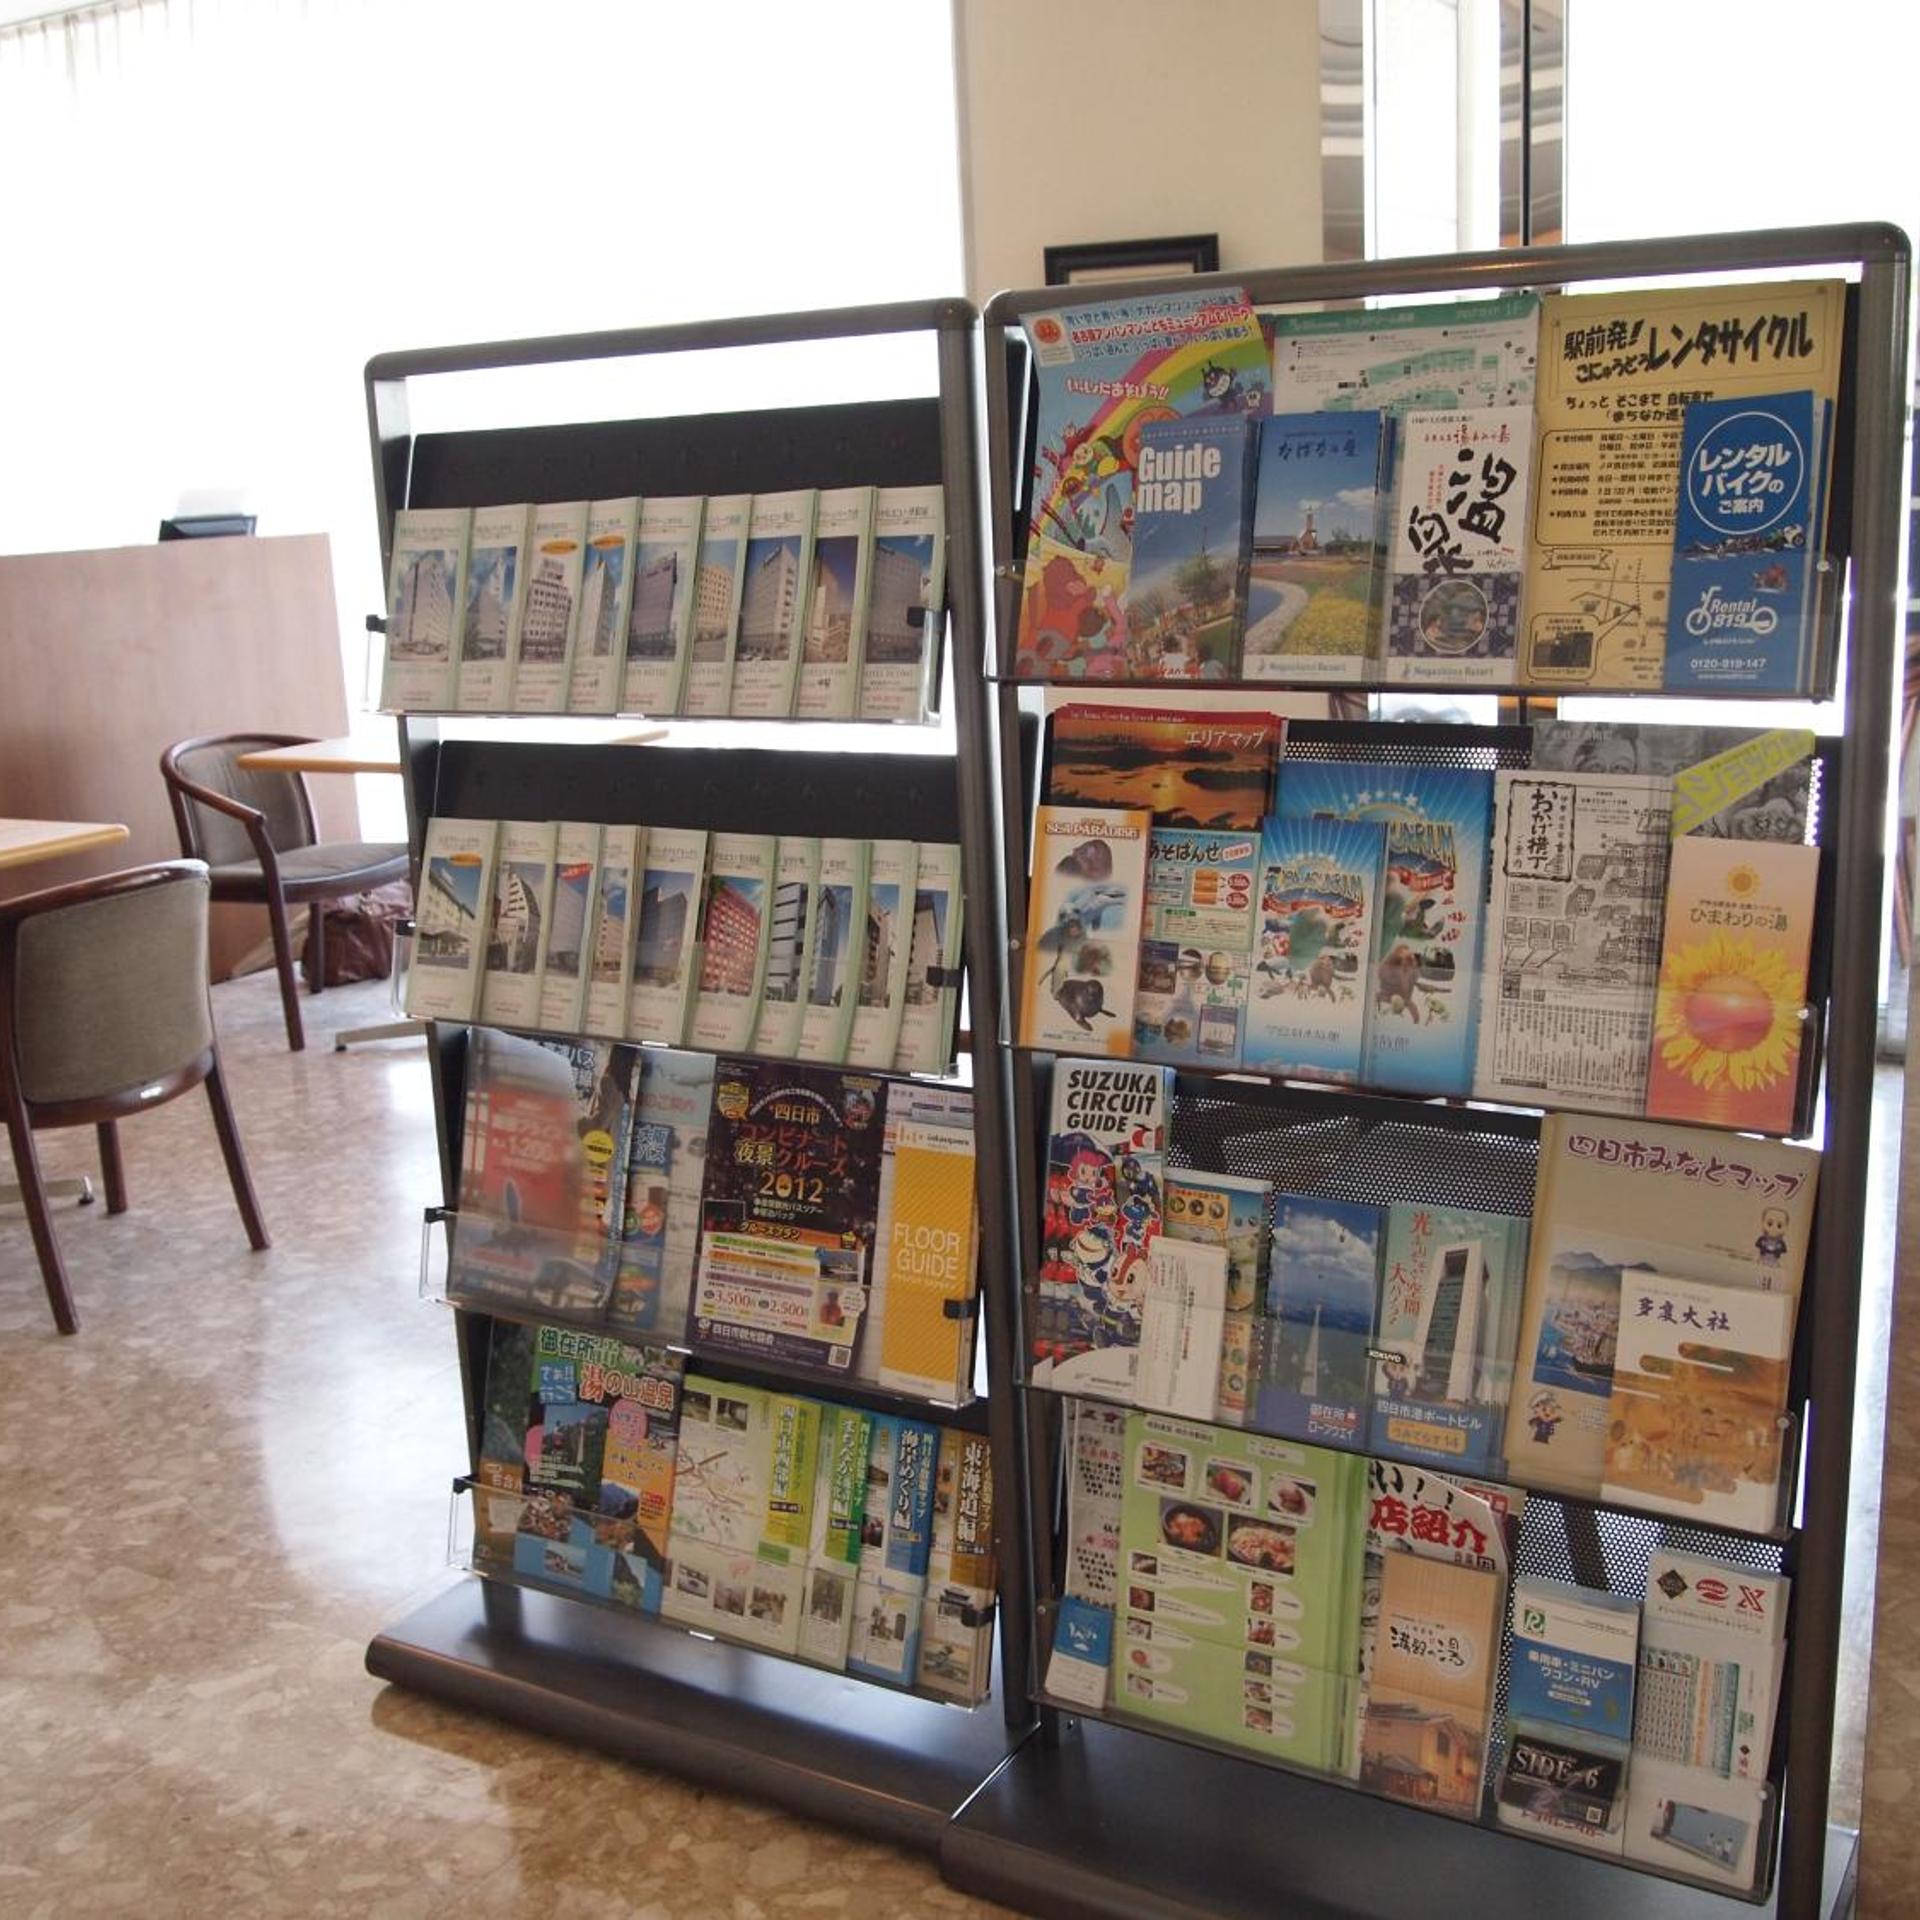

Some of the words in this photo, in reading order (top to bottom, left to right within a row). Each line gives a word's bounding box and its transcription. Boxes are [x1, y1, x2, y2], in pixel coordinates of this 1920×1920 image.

[1648, 312, 1814, 370] レンタサイクル
[1138, 443, 1221, 482] Guide
[1700, 443, 1792, 472] レンタル
[1136, 480, 1203, 514] map
[1701, 470, 1784, 497] バイクの
[1718, 498, 1764, 515] ご案内
[1710, 598, 1755, 613] Rental
[1712, 613, 1745, 627] 819
[1184, 728, 1266, 748] エリアマップ
[1527, 787, 1559, 869] おかげ横丁
[1689, 906, 1788, 931] ひまわりの湯
[1067, 1070, 1157, 1094] SUZUKA
[774, 1104, 822, 1124] 四日市
[1067, 1090, 1156, 1116] CIRCUIT
[1067, 1112, 1129, 1133] GUIDE
[1568, 1135, 1806, 1197] 四日市みなとマップ
[759, 1170, 824, 1203] 2012
[894, 1222, 961, 1255] FLOOR
[896, 1247, 960, 1281] GUIDE
[579, 1361, 675, 1411] 湯の山温泉
[1370, 1494, 1488, 1554] 店紹介
